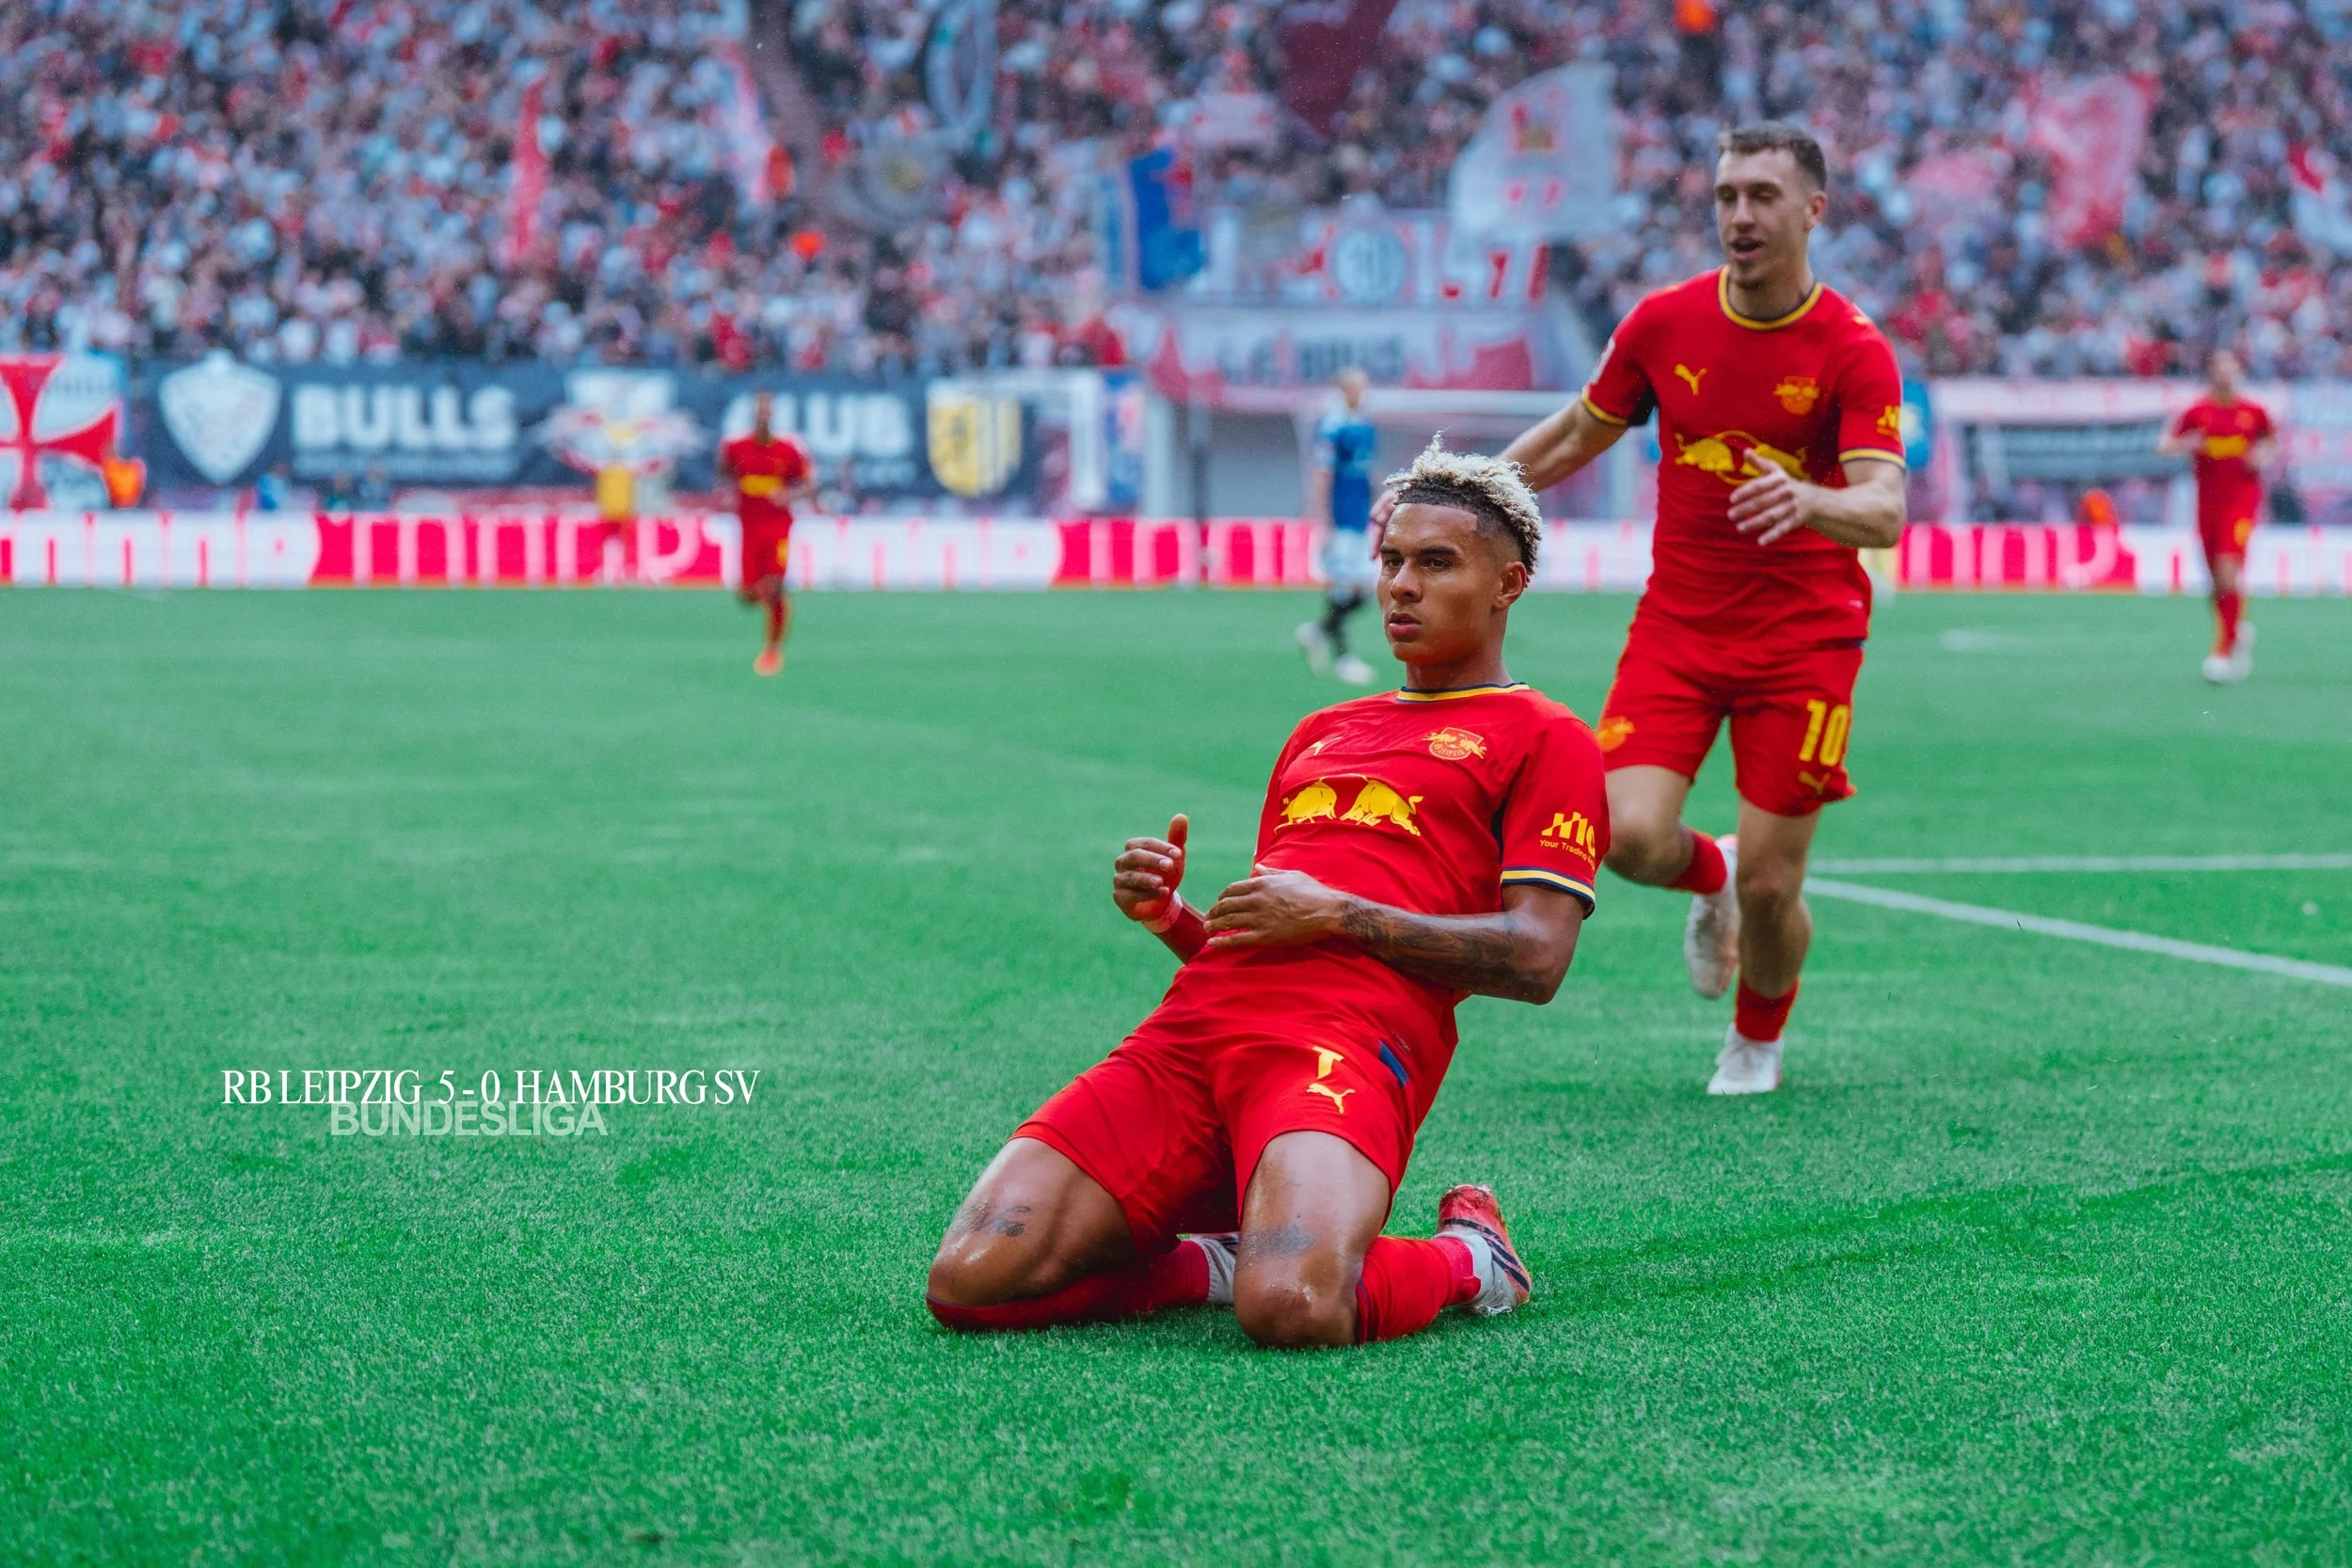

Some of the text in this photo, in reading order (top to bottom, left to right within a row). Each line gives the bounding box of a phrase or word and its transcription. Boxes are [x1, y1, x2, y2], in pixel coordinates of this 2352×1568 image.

[293, 384, 516, 451] BULLS
[1799, 698, 1850, 767] 10
[1539, 839, 1588, 862] Your Trading
